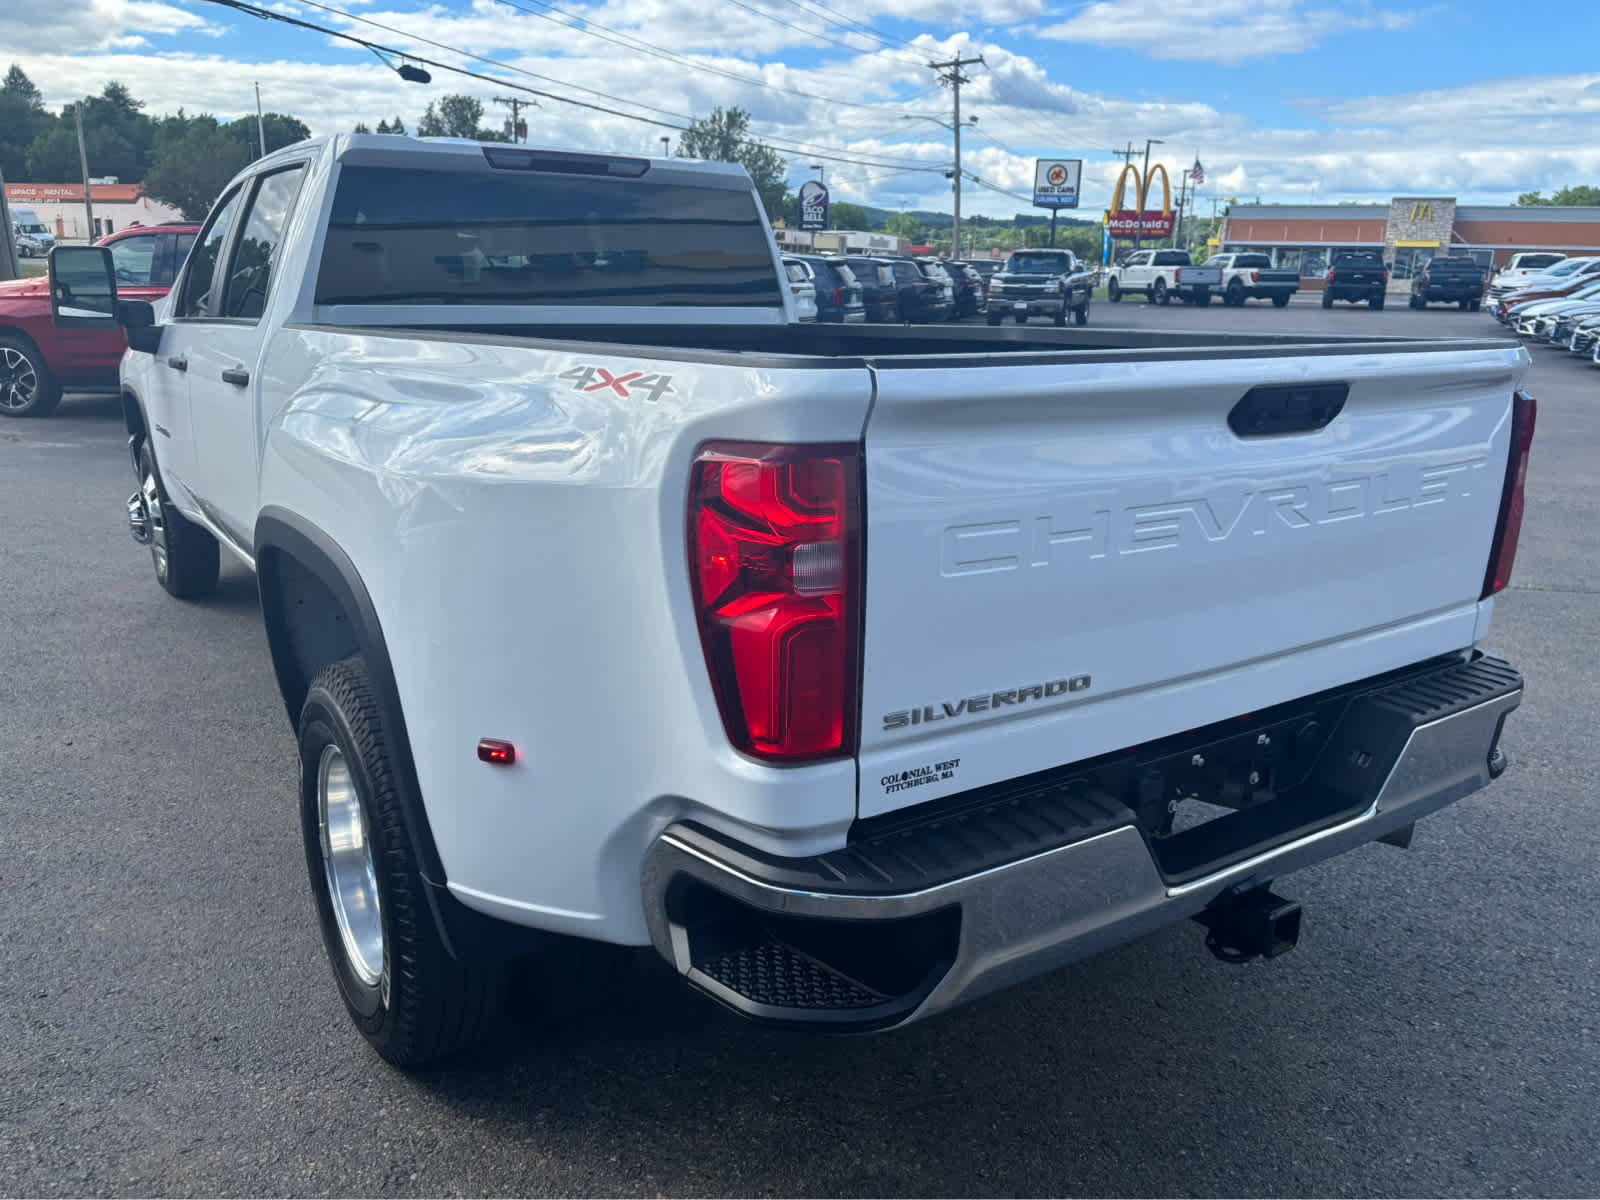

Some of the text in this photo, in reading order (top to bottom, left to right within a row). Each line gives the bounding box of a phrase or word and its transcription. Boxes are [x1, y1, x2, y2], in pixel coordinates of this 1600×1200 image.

[802, 206, 824, 214] TACO
[803, 213, 824, 221] BELL
[939, 456, 1489, 578] CHEVROLET
[882, 673, 1093, 732] SILVERADO
[880, 758, 961, 786] COLONIAL WEST
[941, 770, 954, 780] MA
